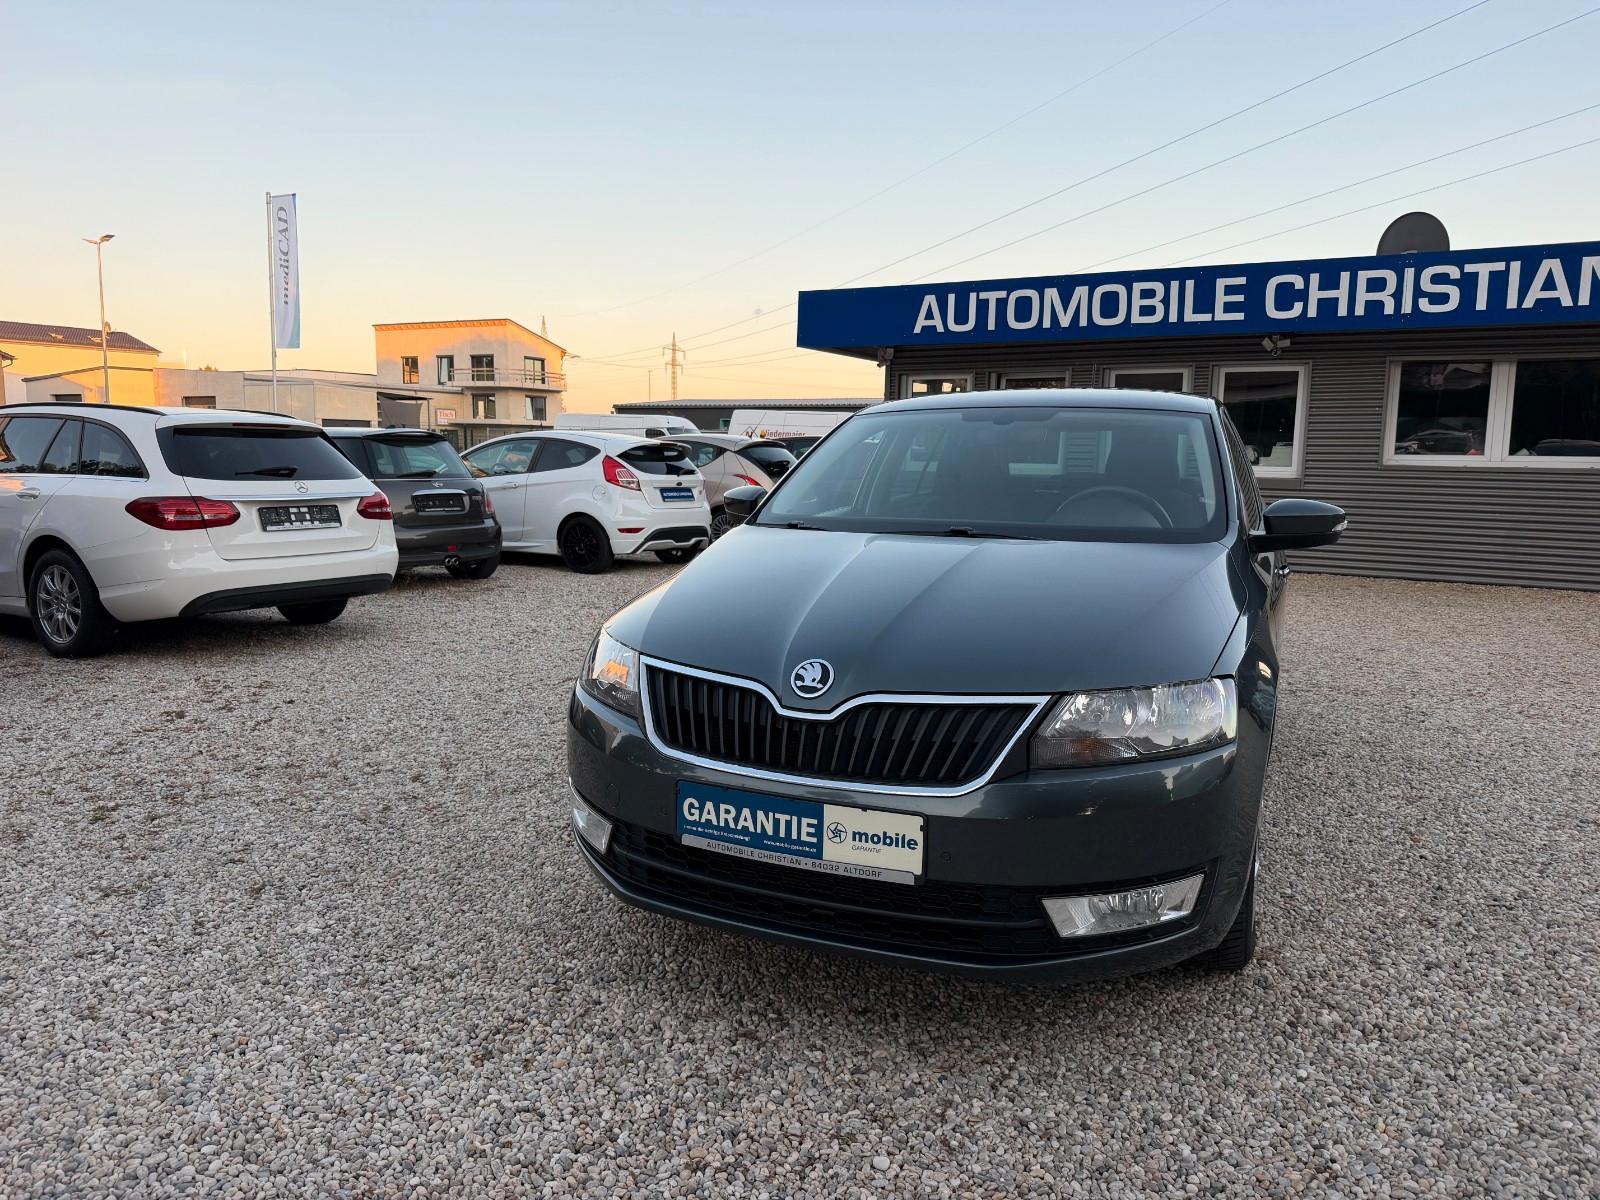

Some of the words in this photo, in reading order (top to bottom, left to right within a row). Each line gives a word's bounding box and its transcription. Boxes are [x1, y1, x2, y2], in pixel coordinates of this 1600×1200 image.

[276, 206, 290, 305] mediCAD
[913, 276, 1247, 333] AUTOMOBILE
[682, 797, 818, 843] GARANTIE
[851, 830, 919, 851] mobile
[706, 841, 756, 858] AUTOMOBILE
[757, 853, 801, 866] CHRISTIAN
[811, 861, 840, 872] 84032
[843, 866, 883, 878] ALTDORF
[851, 844, 882, 854] GARANTIE
